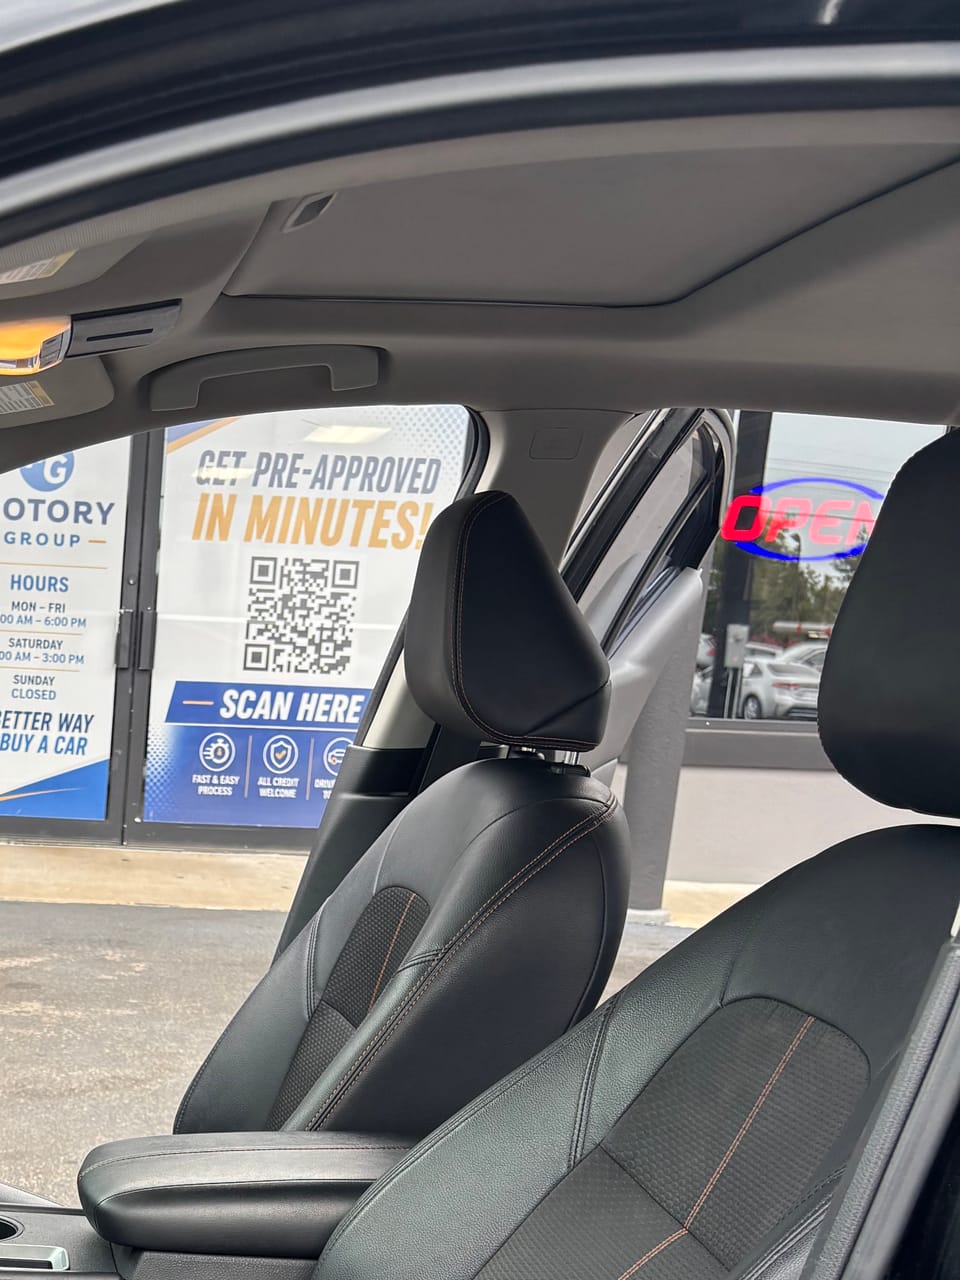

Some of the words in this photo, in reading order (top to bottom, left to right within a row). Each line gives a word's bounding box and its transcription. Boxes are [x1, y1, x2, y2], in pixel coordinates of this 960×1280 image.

[196, 450, 247, 487] GET
[252, 452, 441, 495] PRE-APPROVED
[191, 492, 237, 541] IN
[243, 495, 434, 550] MINUTES!
[4, 531, 81, 547] GROUP
[10, 574, 69, 592] HOURS
[11, 601, 36, 612] MON
[48, 603, 66, 613] FRI
[16, 615, 33, 625] AM
[44, 616, 68, 626] 6:00
[71, 618, 87, 628] PM
[8, 638, 63, 650] SATURDAY
[14, 652, 31, 661] AM
[42, 653, 66, 663] 3:00
[69, 655, 84, 664] PM
[13, 675, 55, 686] SUNDAY
[11, 688, 56, 701] CLOSED
[219, 688, 294, 721] SCAN
[296, 692, 365, 723] HERE
[58, 712, 95, 733] WAY
[0, 733, 34, 753] BUY
[37, 735, 48, 754] A
[54, 736, 88, 756] CAR
[192, 774, 211, 784] FAST
[220, 775, 240, 786] EASY
[257, 777, 272, 786] ALL
[274, 777, 300, 787] CREDIT
[198, 786, 233, 796] PROCESS
[259, 788, 297, 799] WELCOME
